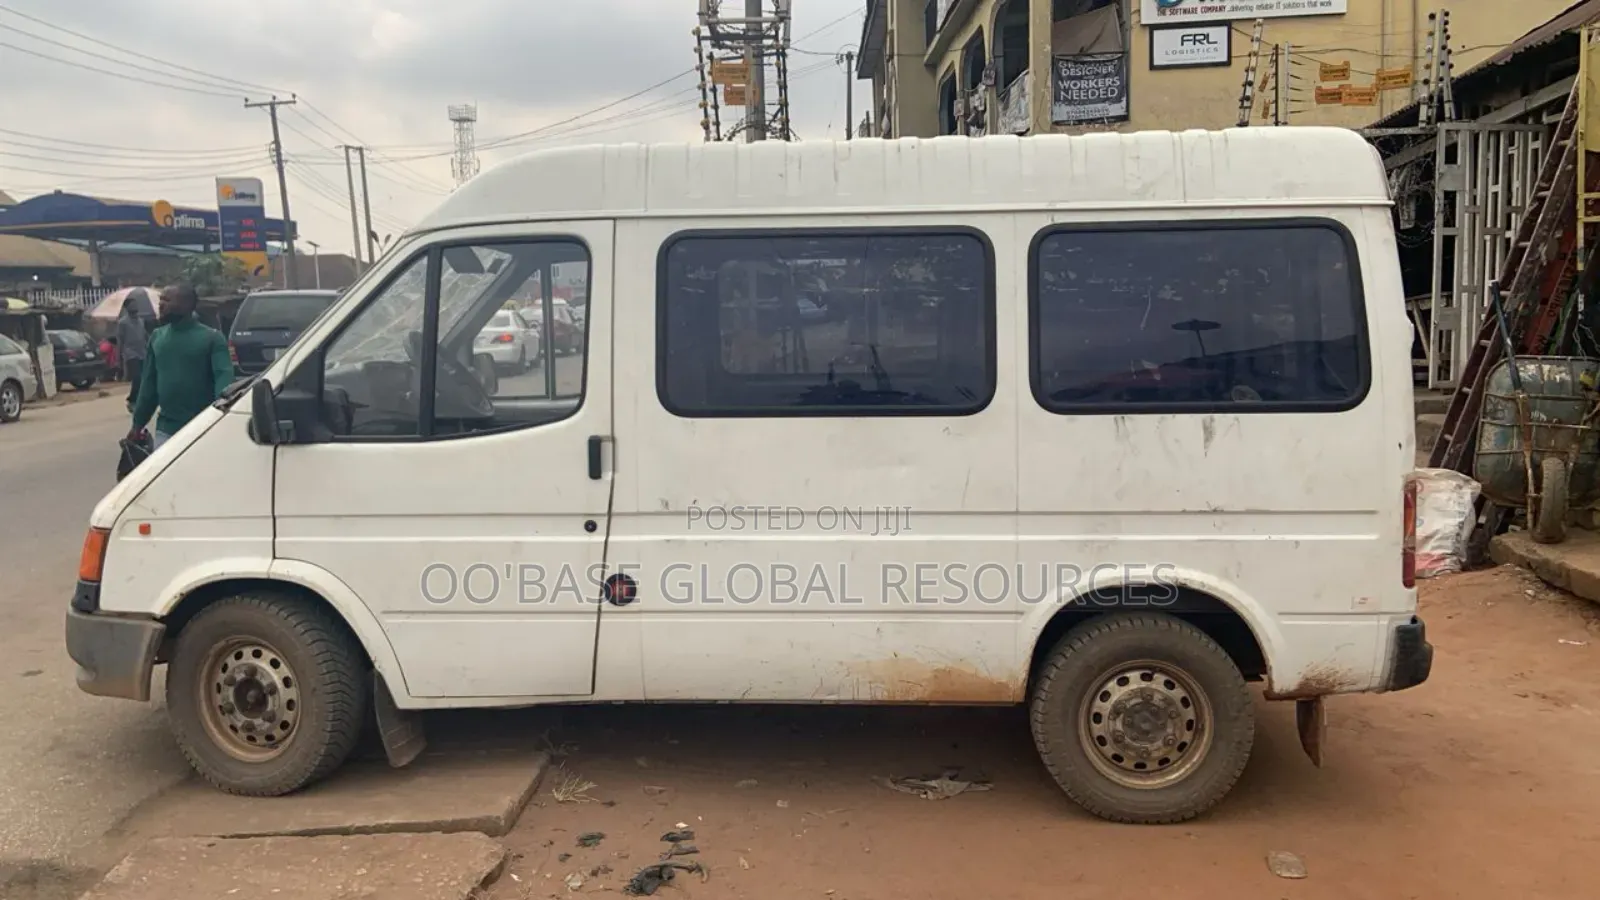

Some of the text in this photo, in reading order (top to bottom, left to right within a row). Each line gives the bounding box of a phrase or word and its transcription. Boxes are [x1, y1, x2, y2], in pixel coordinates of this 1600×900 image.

[1157, 7, 1167, 17] THE
[1169, 7, 1198, 16] SOFTWARE
[1200, 5, 1226, 14] COMPANY
[1180, 33, 1218, 47] FRL
[1164, 47, 1219, 56] LOGISTICS
[1062, 65, 1115, 76] DESIGNER
[1058, 77, 1120, 89] WORKERS
[1060, 87, 1118, 100] NEEDED
[164, 214, 205, 229] Optima
